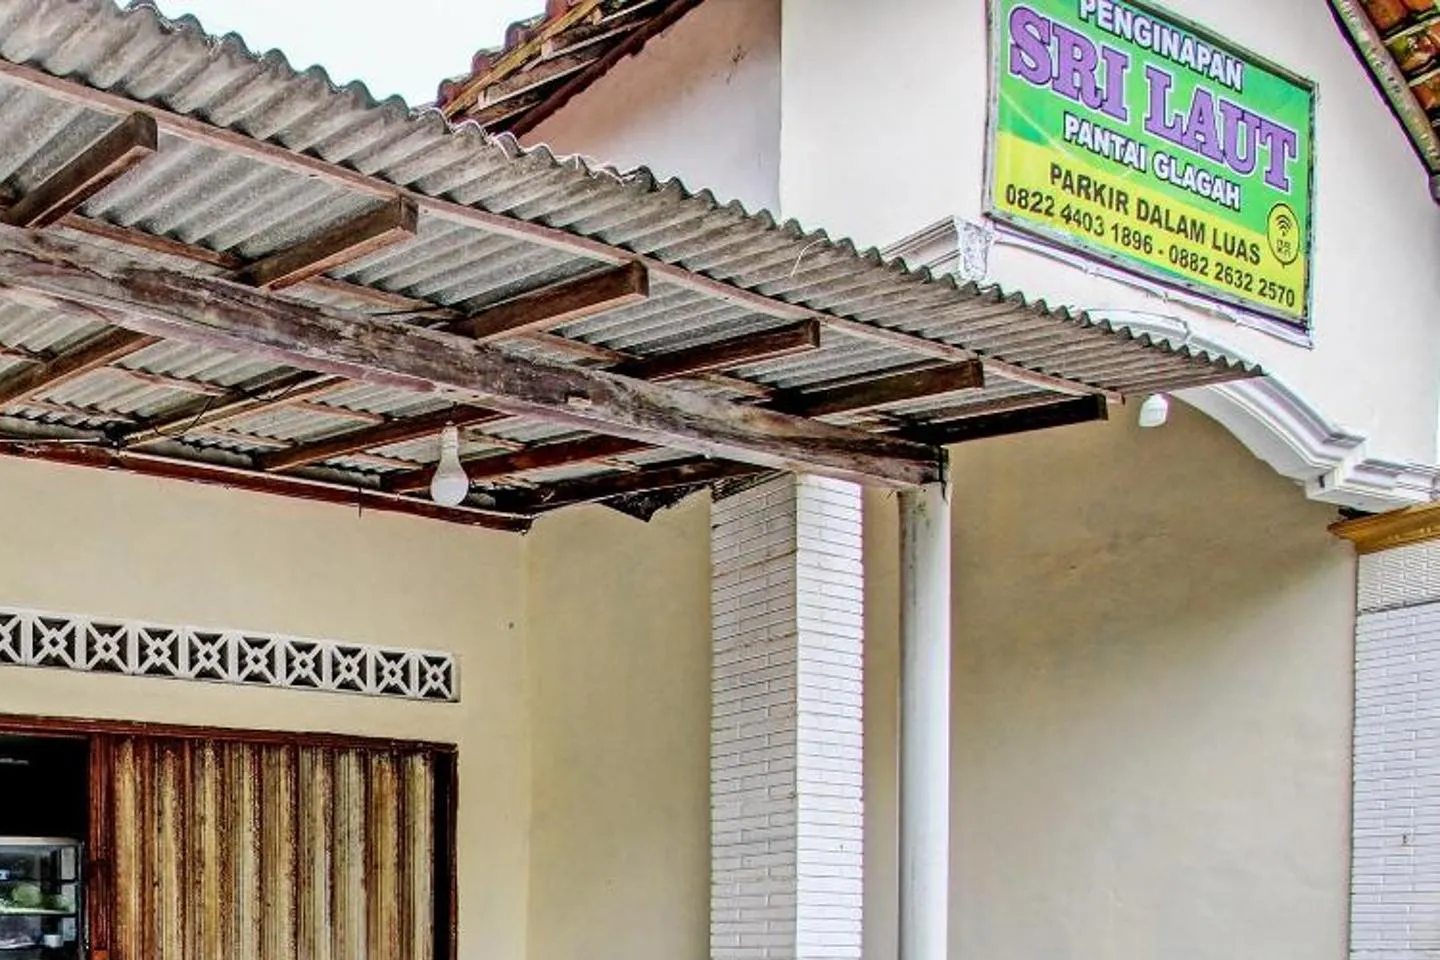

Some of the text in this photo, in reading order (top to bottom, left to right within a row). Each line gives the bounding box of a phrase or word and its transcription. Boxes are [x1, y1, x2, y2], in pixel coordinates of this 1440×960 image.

[1008, 5, 1297, 193] SRI LAUT
[1078, 0, 1244, 94] PENGINAPAN
[1064, 111, 1241, 212] PANTAI GLAGAH
[1005, 183, 1055, 217] 0822
[1060, 203, 1105, 237] 4403
[1111, 222, 1153, 255] 1896
[1168, 244, 1209, 277] 0882
[1214, 262, 1253, 293] 2632
[1258, 277, 1295, 308] 2570
[1049, 162, 1261, 266] PARKIR DALAM LUAS
